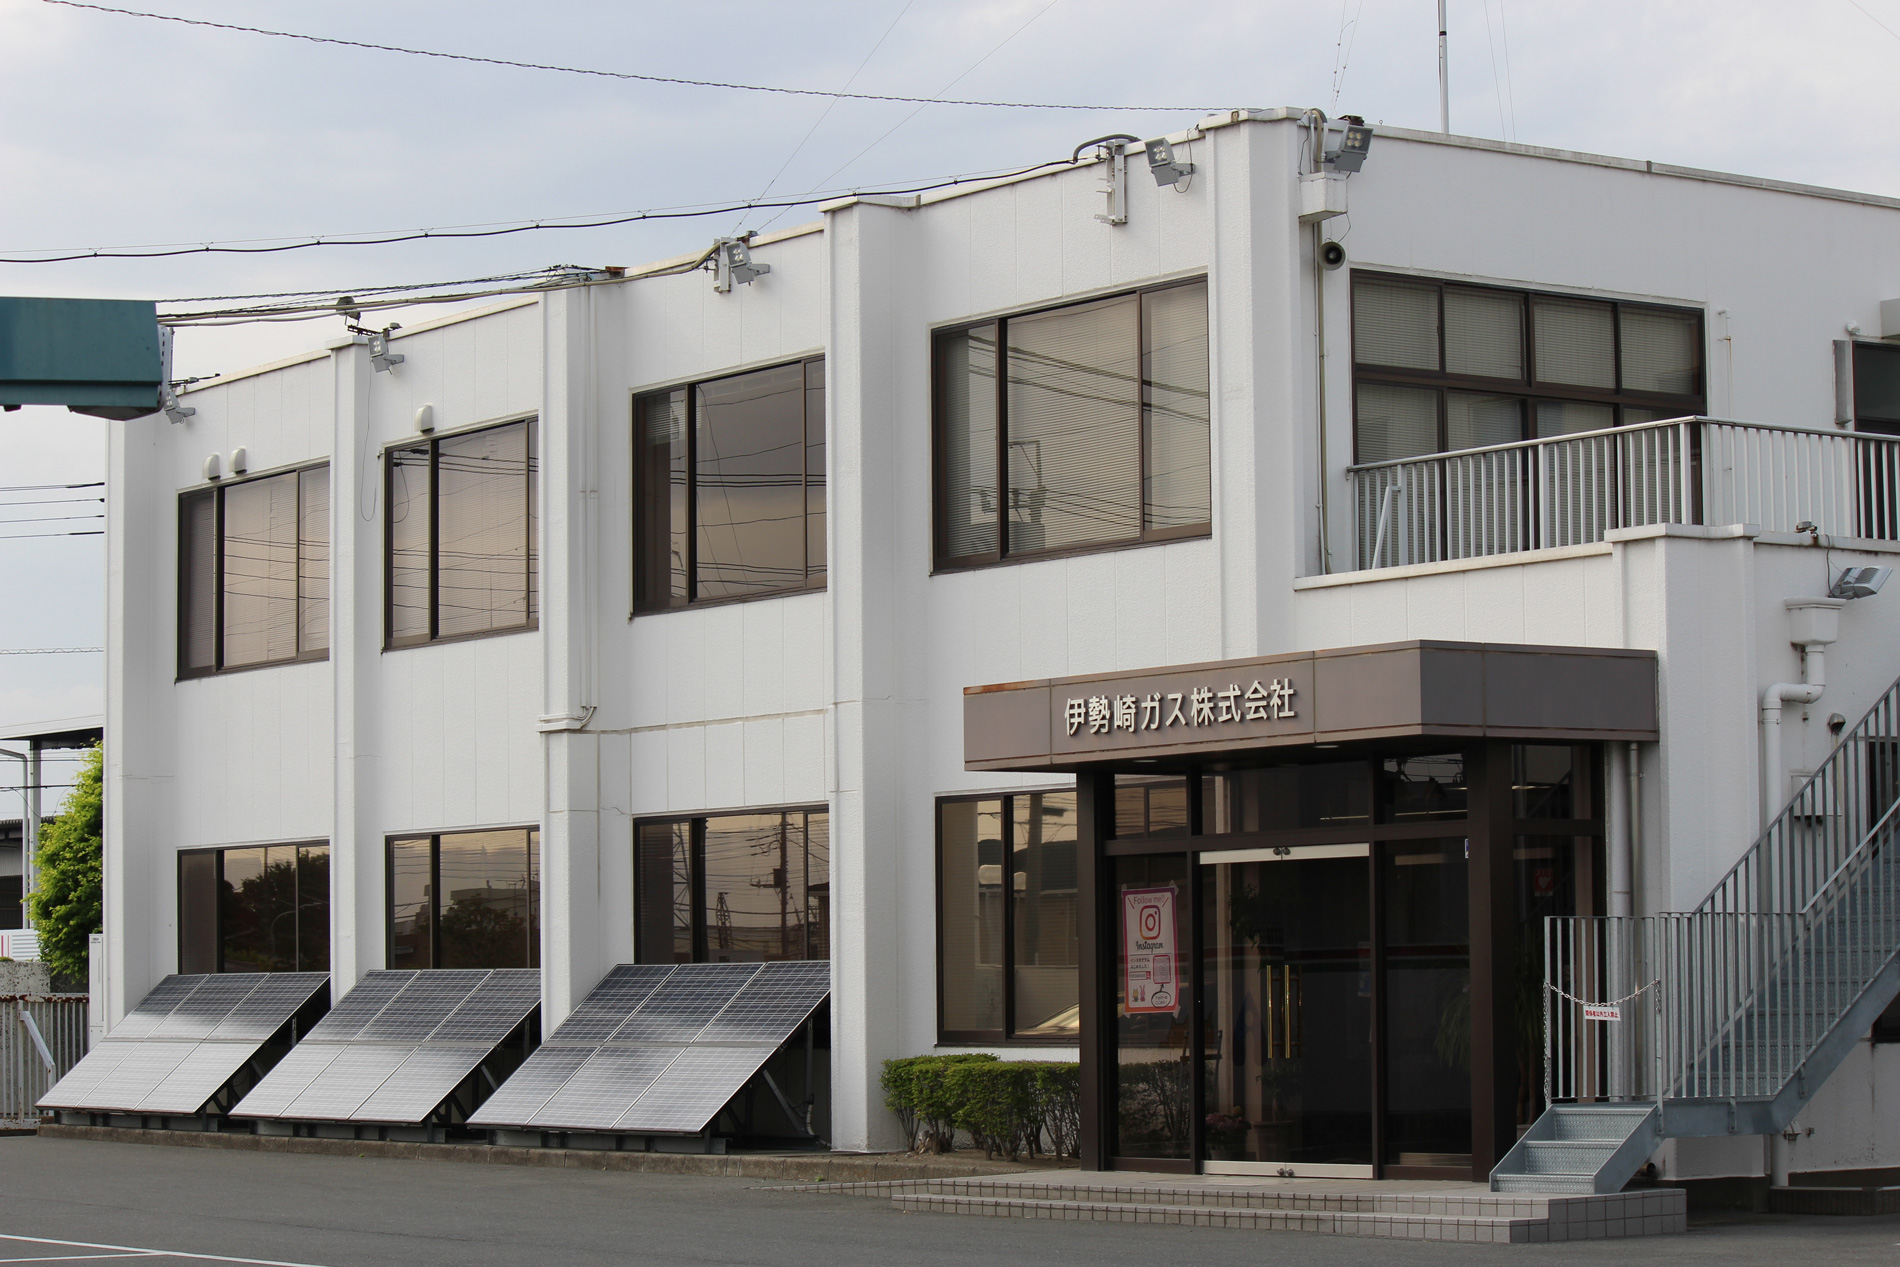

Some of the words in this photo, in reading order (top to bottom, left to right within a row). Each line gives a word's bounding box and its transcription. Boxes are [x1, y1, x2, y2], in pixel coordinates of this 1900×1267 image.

[1064, 678, 1296, 736] 伊勢崎ガス株式会社
[1133, 896, 1153, 904] Follow
[1135, 940, 1164, 954] Instagram
